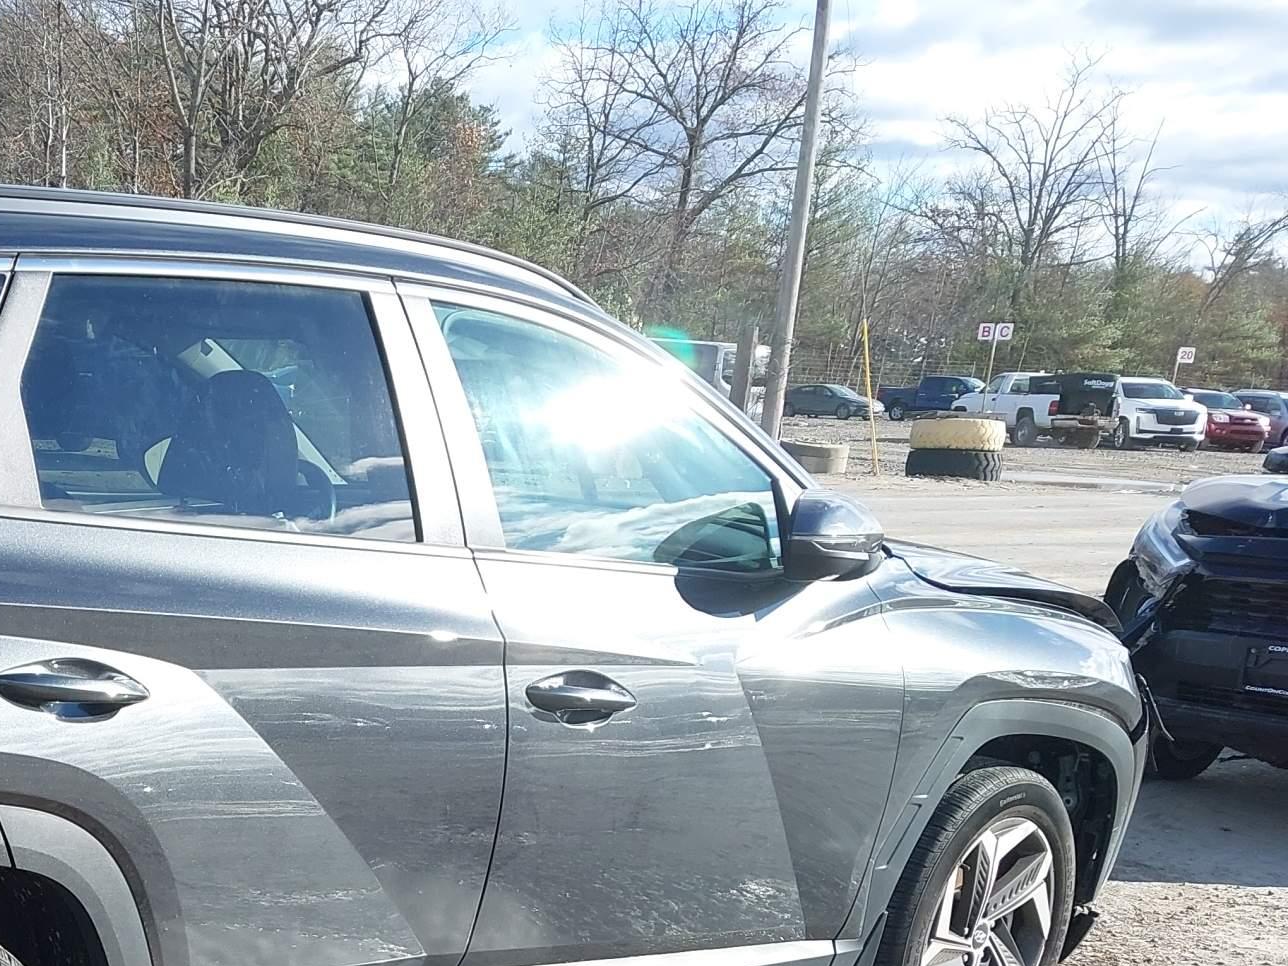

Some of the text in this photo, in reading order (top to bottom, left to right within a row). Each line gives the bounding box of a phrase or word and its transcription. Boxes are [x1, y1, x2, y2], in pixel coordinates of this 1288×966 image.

[982, 326, 991, 338] B
[1000, 325, 1010, 338] C
[1179, 350, 1193, 360] 20
